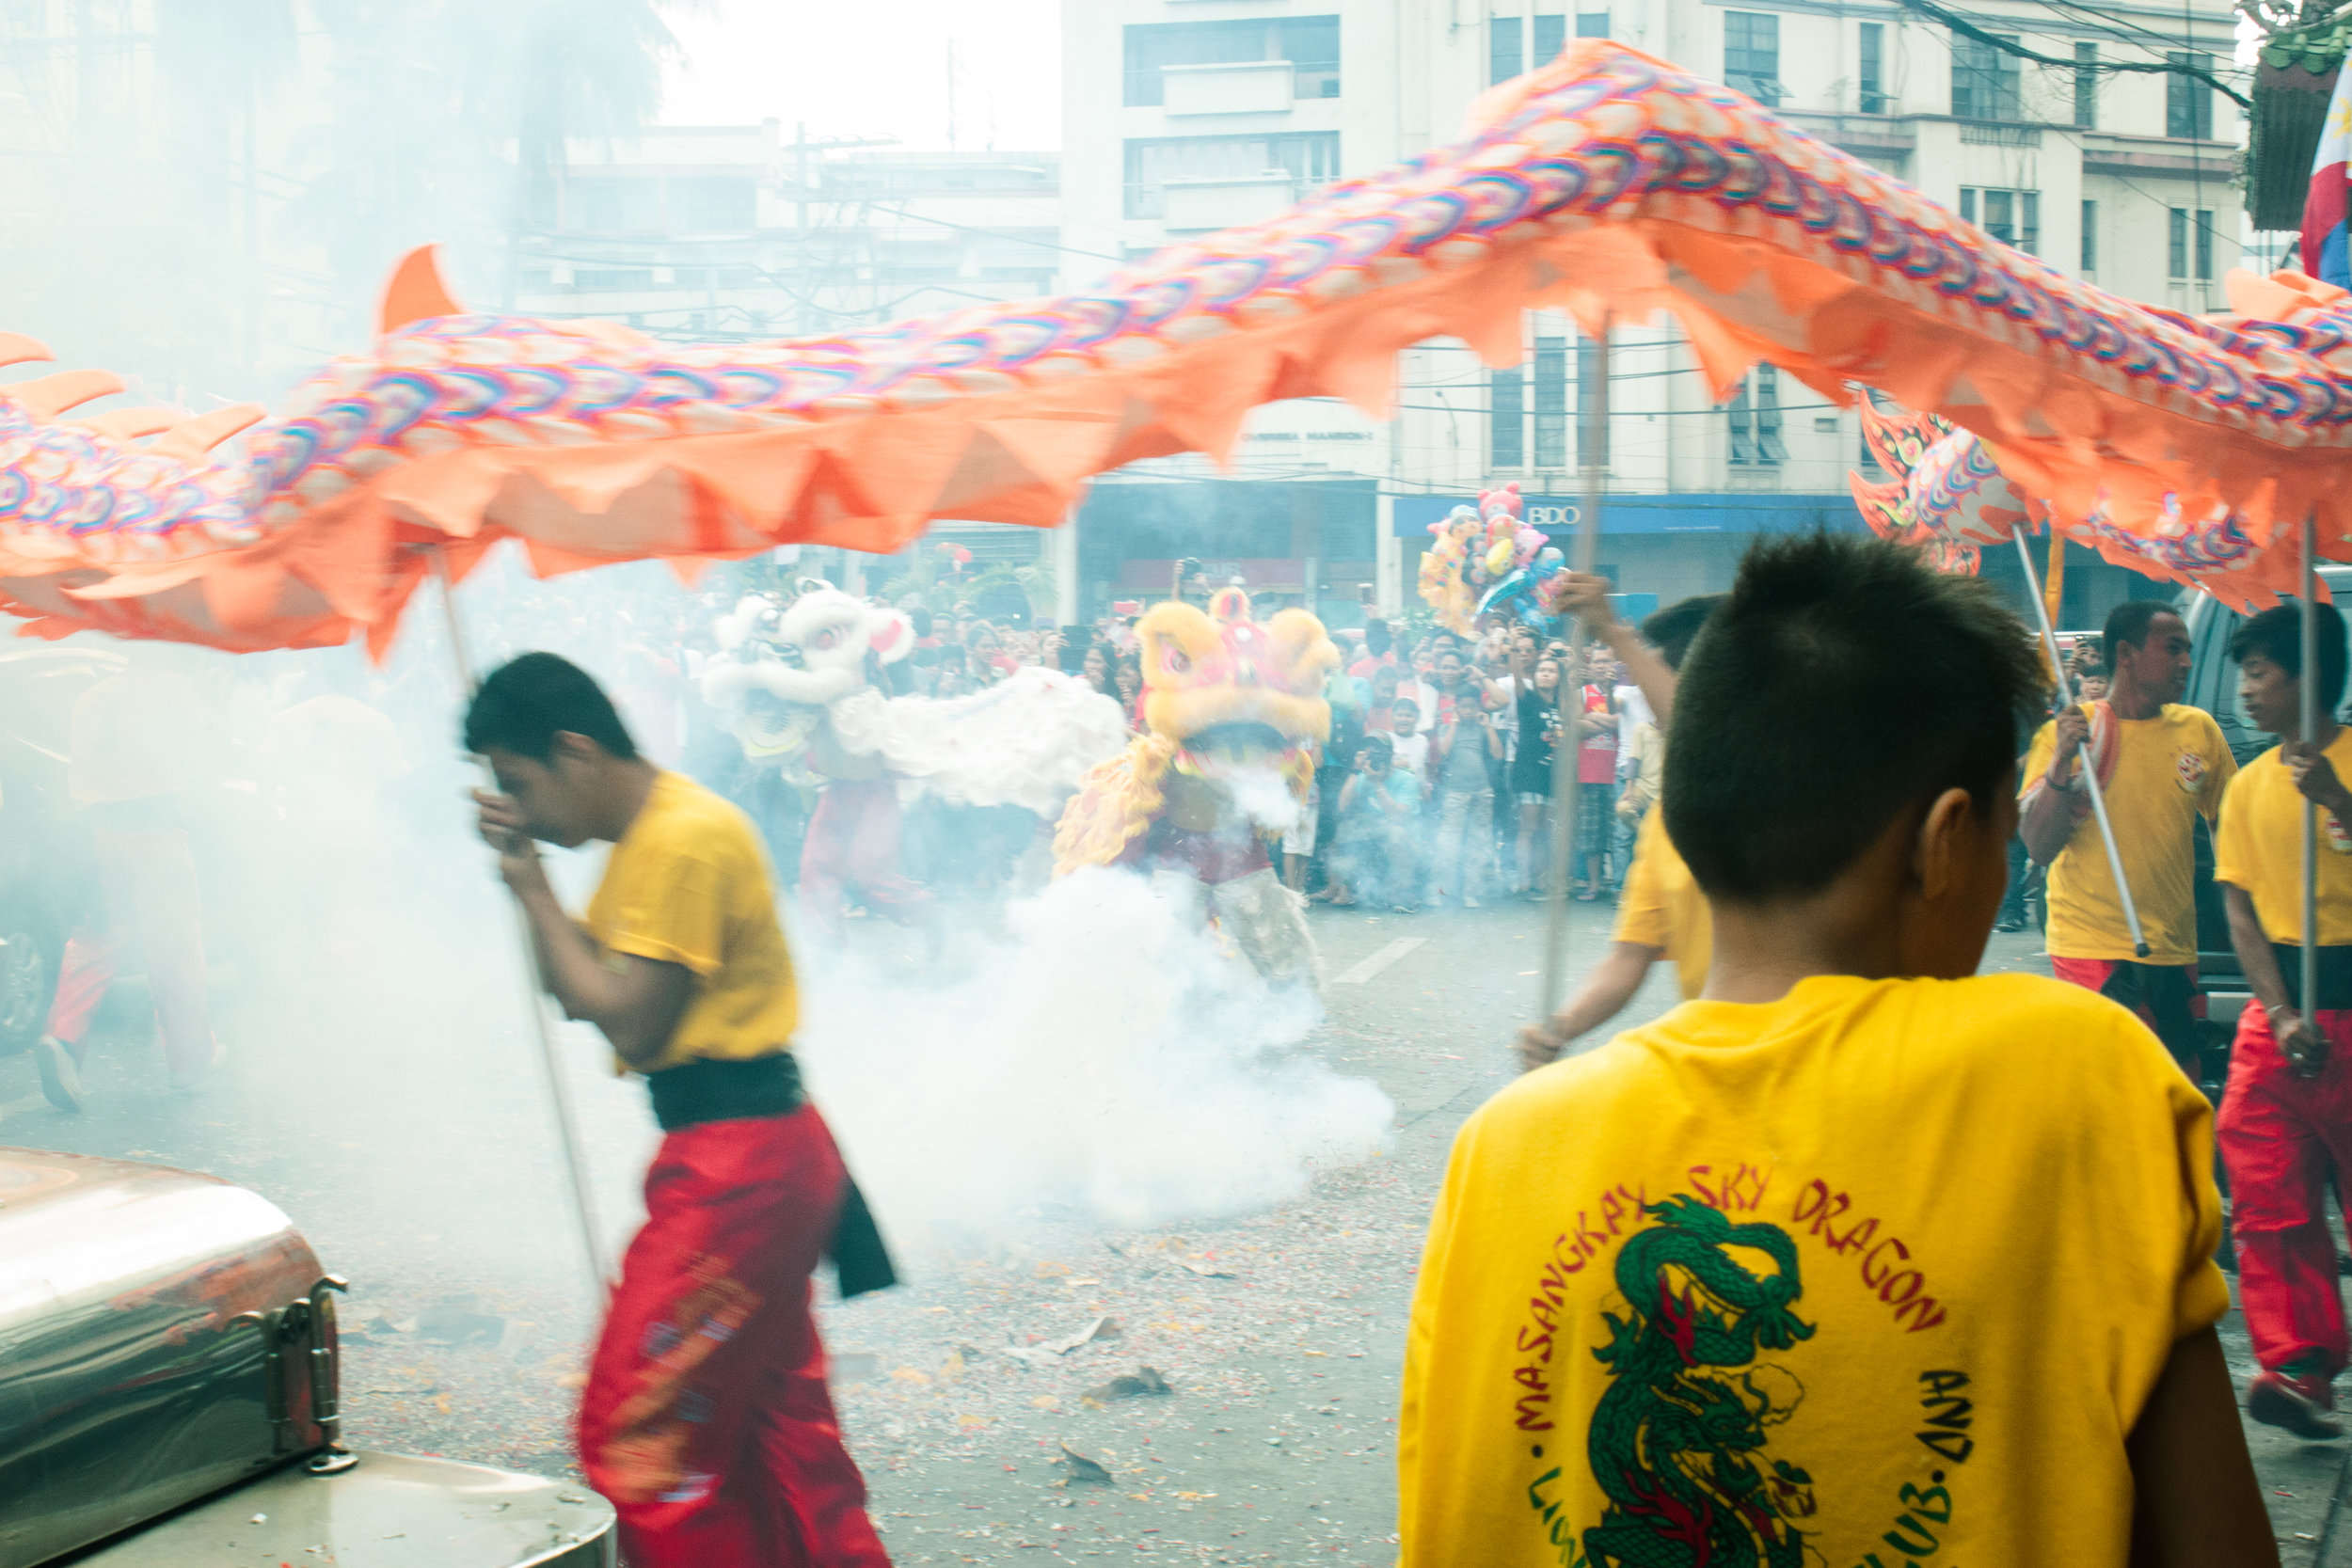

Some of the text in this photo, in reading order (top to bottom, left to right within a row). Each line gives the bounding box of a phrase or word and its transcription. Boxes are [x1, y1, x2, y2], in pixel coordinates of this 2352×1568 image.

[1529, 506, 1581, 525] BDO
[1513, 1164, 1947, 1432] MASANGKAY SKY DRAGON
[1915, 1370, 1975, 1464] AND
